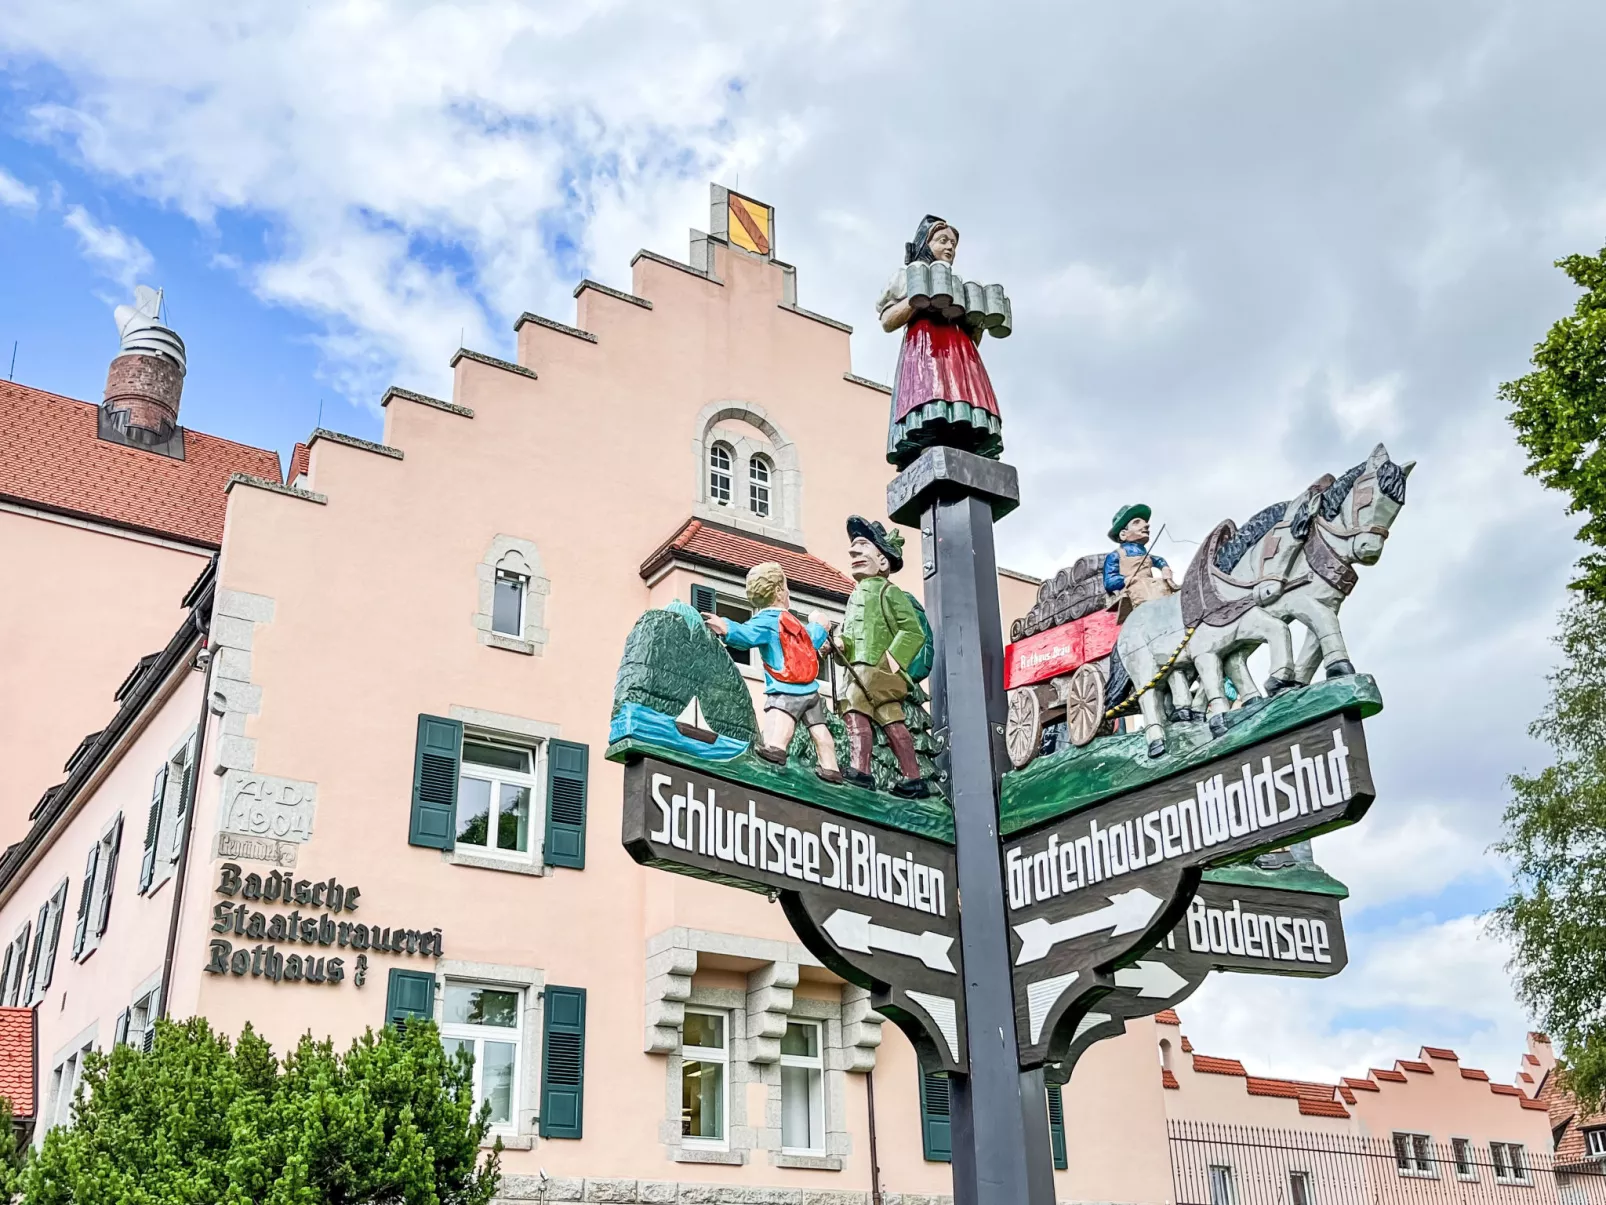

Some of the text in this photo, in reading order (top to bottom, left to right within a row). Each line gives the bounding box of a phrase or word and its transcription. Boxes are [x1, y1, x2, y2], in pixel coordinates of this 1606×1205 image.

[650, 772, 821, 884] Schluchsee
[1006, 728, 1352, 911] Grafenhausen Waldshut
[215, 862, 361, 914] Badische
[203, 938, 345, 983] Rothaus
[211, 900, 444, 958] Staatsbrauerei
[1187, 894, 1332, 964] Bodensee
